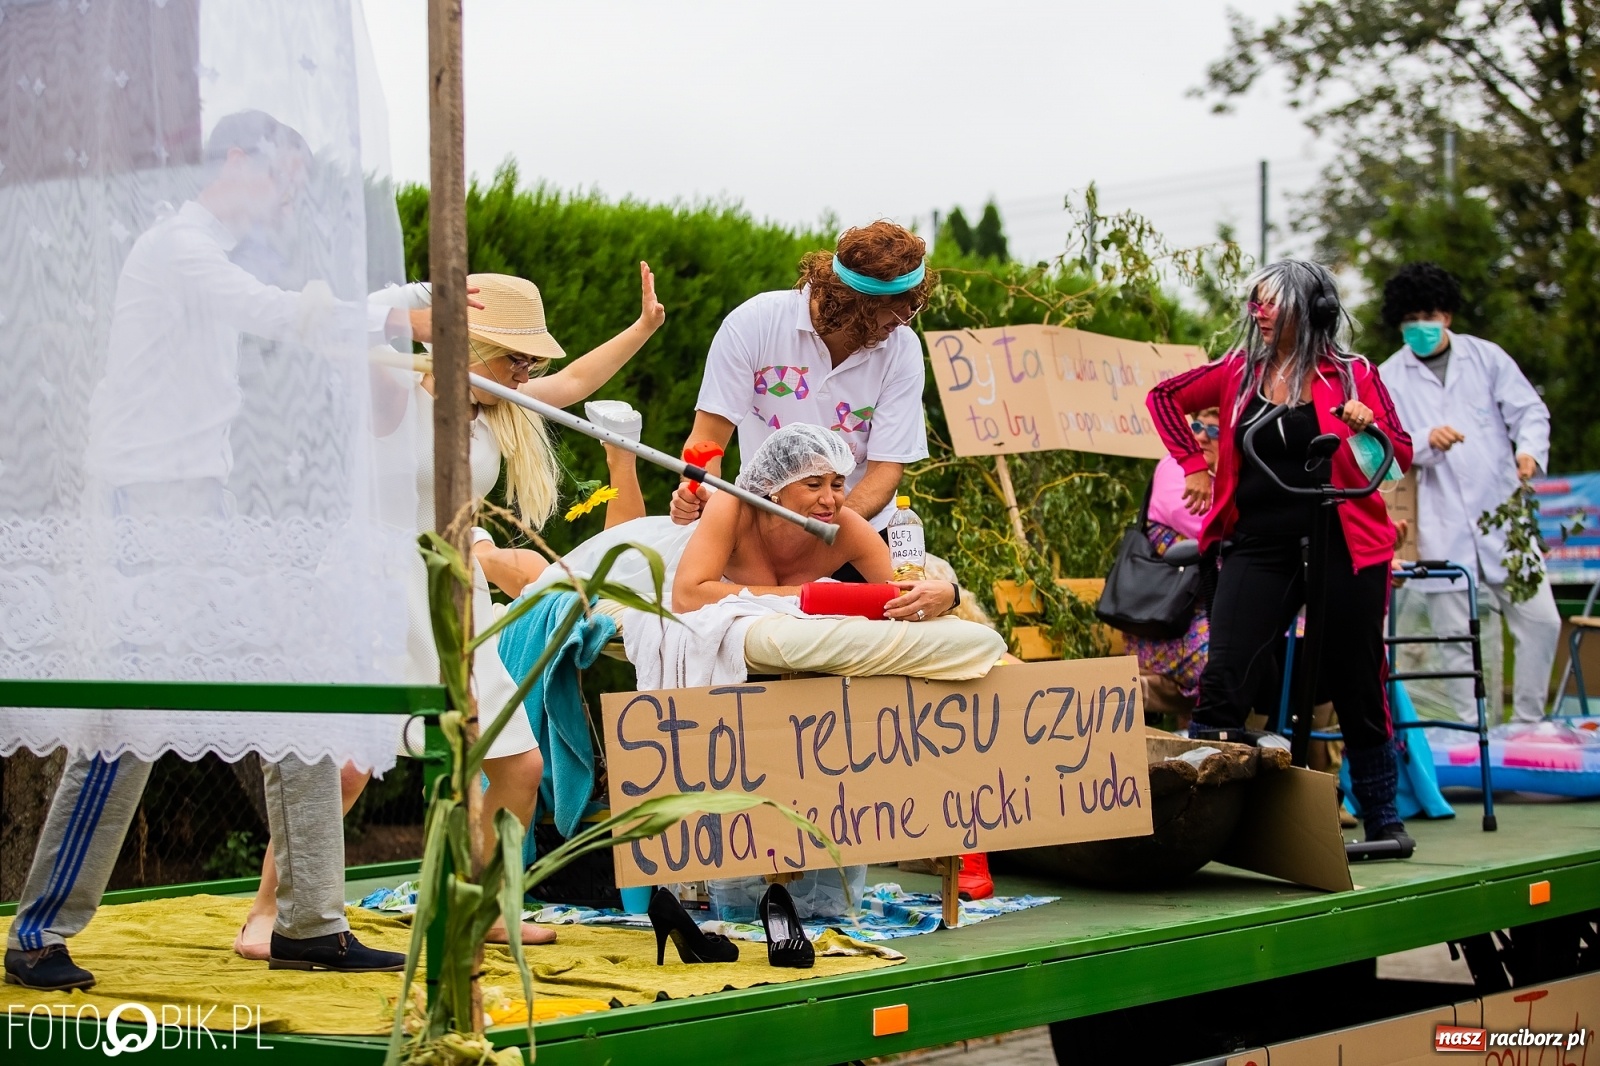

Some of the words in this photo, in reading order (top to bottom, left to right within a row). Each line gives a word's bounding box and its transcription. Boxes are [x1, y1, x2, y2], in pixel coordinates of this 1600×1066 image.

[934, 335, 996, 405] By
[965, 405, 1000, 442] to
[891, 530, 912, 543] OLEJ
[1023, 676, 1138, 774] czyni
[942, 767, 1032, 849] cycki
[1058, 772, 1066, 818] i
[1079, 752, 1142, 814] uda
